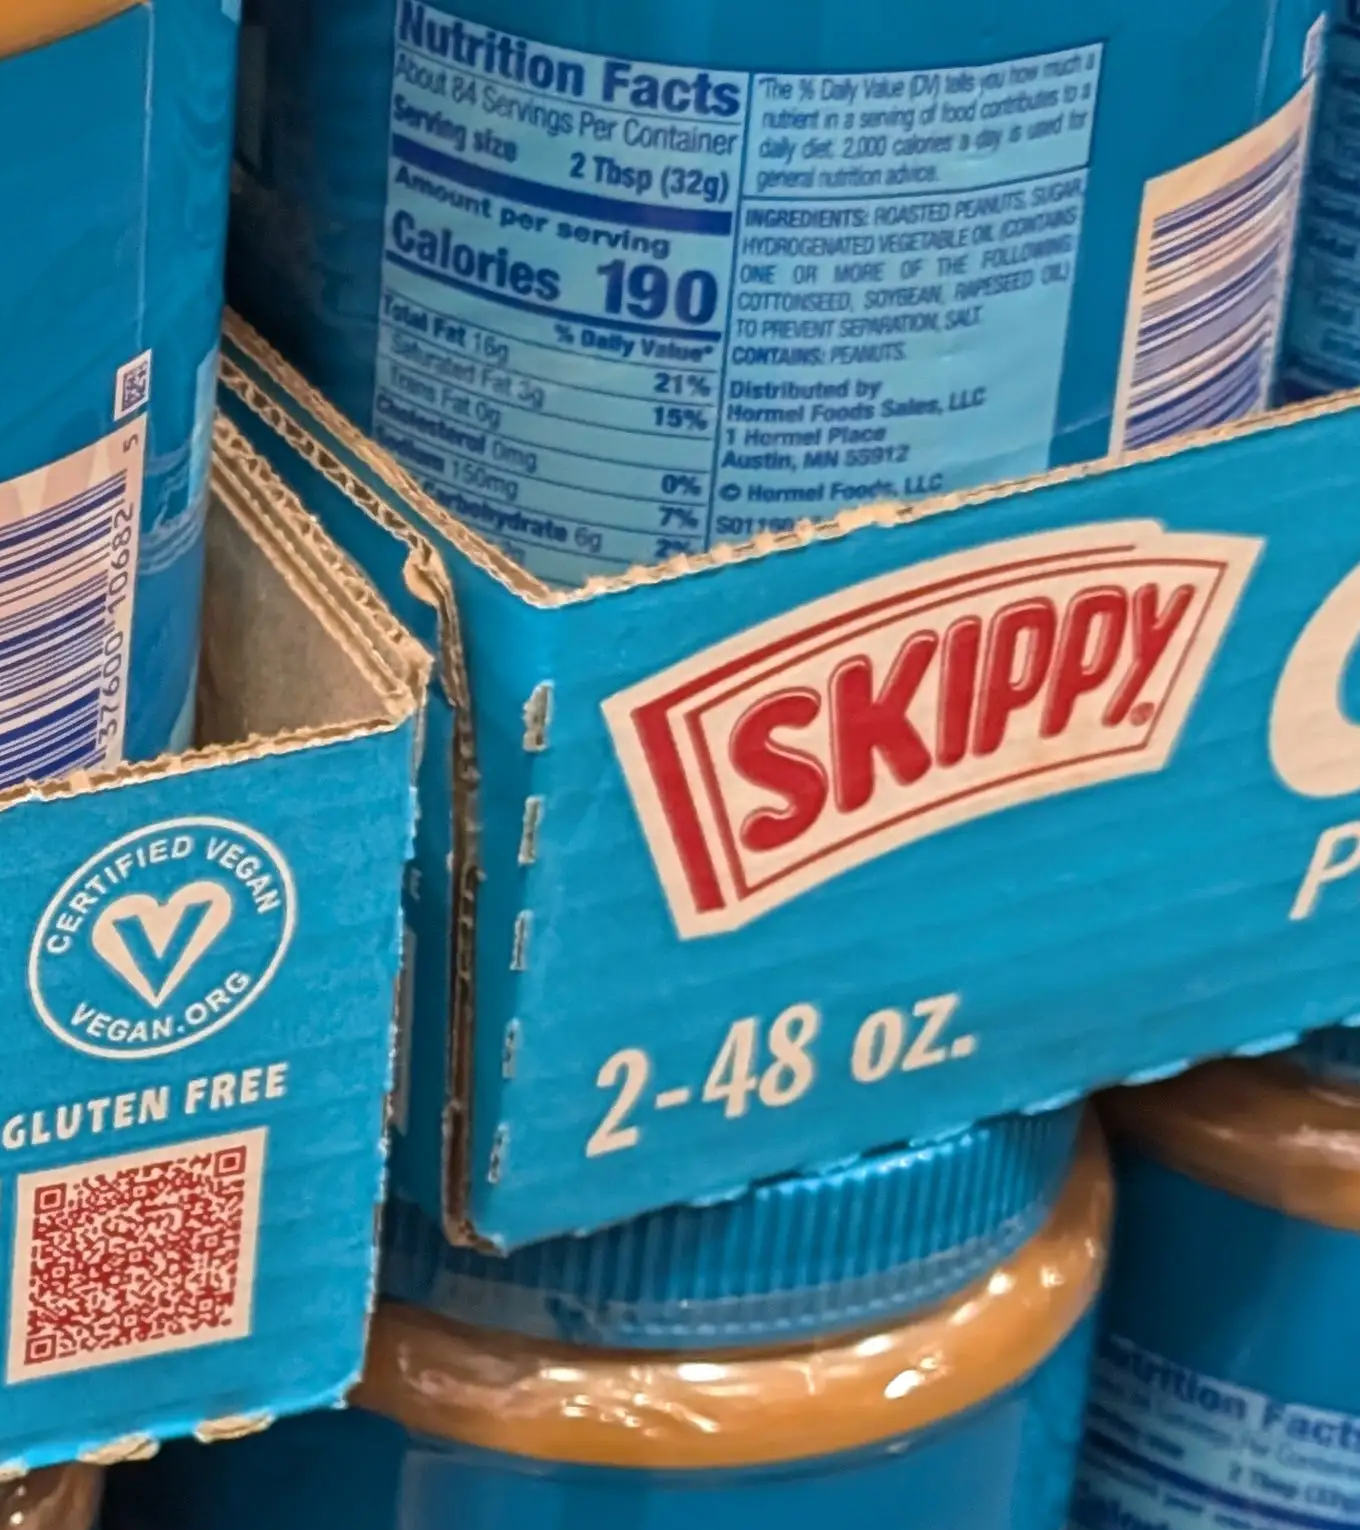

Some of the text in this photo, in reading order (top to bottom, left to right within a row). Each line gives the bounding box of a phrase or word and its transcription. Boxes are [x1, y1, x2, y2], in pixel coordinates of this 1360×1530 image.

[399, 1, 740, 117] Nutrition Facts
[570, 152, 728, 203] 2 Tbsp (32g)
[623, 118, 738, 156] Container
[392, 209, 718, 325] Calories 190
[98, 503, 133, 746] 37600 10682
[726, 582, 1196, 852] SKIPPY
[46, 835, 281, 955] CERTIFIED VEGAN
[71, 971, 251, 1043] VEGAN.ORG
[1, 1062, 289, 1151] GLUTEN FREE
[585, 992, 977, 1158] 2-48 oz.
